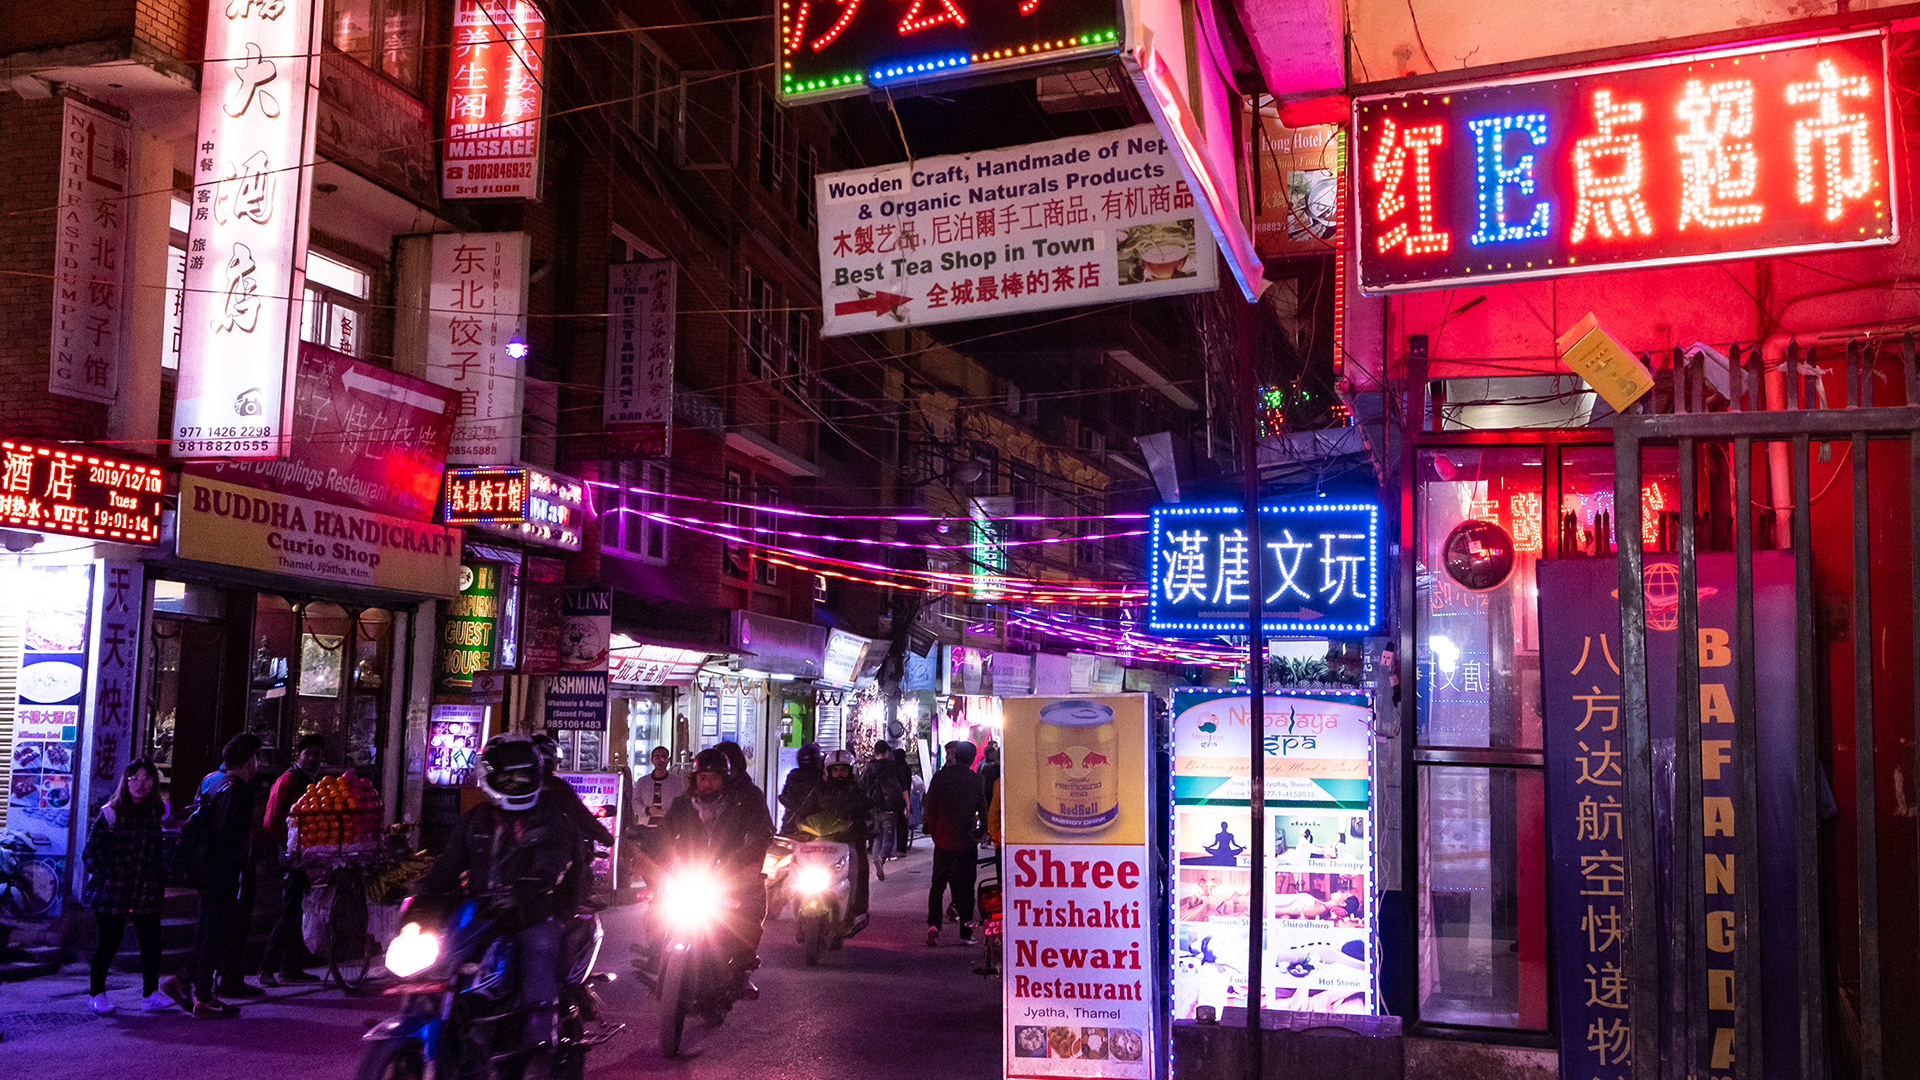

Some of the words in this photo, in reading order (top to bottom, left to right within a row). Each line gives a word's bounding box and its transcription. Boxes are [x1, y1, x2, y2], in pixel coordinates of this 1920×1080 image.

[450, 27, 491, 119] 养生阁
[501, 25, 542, 118] 中式按摩
[451, 121, 535, 140] CHINESE
[1293, 131, 1322, 149] Hotel
[201, 141, 215, 172] 中餐
[449, 140, 535, 157] MASSAGE
[1374, 58, 1873, 256] 红E点超市
[468, 162, 532, 180] 9803846932
[829, 175, 903, 199] Wooden
[911, 165, 971, 188] Craft,
[977, 149, 1095, 179] Handmade
[1098, 140, 1120, 159] of
[1127, 135, 1170, 157] Nep
[456, 184, 479, 194] 3rd
[482, 183, 520, 194] FLOOR
[858, 203, 874, 221] &
[877, 191, 962, 222] Organic
[967, 176, 1059, 203] Naturals
[1066, 161, 1165, 190] Products
[195, 189, 211, 221] 客房
[190, 238, 207, 270] 旅游
[835, 262, 884, 287] Best
[892, 257, 933, 279] Tea
[939, 247, 998, 277] Shop
[1004, 243, 1025, 263] in
[1032, 235, 1095, 260] Town
[84, 197, 119, 389] 东北饺子馆
[490, 241, 501, 347] DUMPLING
[926, 262, 1101, 309] 全城最棒的茶店
[486, 352, 496, 418] HOUSE
[619, 411, 643, 421] BAR
[178, 441, 269, 451] 9818820555
[180, 427, 201, 438] 977
[208, 427, 237, 438] 1426
[240, 427, 271, 438] 2298
[2, 451, 78, 501] 酒店
[90, 466, 159, 494] 2019/12/10
[325, 467, 389, 499] Restaurant
[109, 490, 138, 510] Tues
[452, 479, 522, 513] 东北饺子馆
[94, 509, 149, 533] 19:01:14
[193, 485, 304, 533] BUDDHA
[314, 509, 457, 557] HANDICRAFT
[267, 532, 327, 560] Curio
[332, 542, 381, 567] Shop
[277, 556, 315, 573] Thamel,
[316, 561, 349, 579] Jyatha,
[350, 565, 371, 579] Ktm.
[1163, 528, 1367, 604] 漢唐文玩
[444, 620, 492, 646] GUEST
[94, 567, 130, 782] 天天快递
[443, 649, 491, 674] HOUSE
[545, 675, 606, 695] PASHMINA
[546, 720, 602, 729] 9851061483
[1264, 763, 1283, 773] ody,
[1285, 762, 1317, 772] Mind
[1331, 762, 1361, 773] Soul
[1290, 780, 1313, 788] Thamel
[1051, 816, 1083, 825] ENERGY
[1083, 815, 1107, 825] DRINK
[1014, 848, 1140, 889] Shree
[1308, 859, 1326, 868] Thai
[1328, 859, 1365, 870] Therapy
[1571, 633, 1634, 1080] 八方达航空快递物
[1014, 899, 1142, 929] Trishakti
[1282, 920, 1330, 929] Shirodhara
[1015, 940, 1142, 970] Newari
[1015, 975, 1142, 1002] Restaurant
[1318, 978, 1334, 987] Hot
[1336, 978, 1361, 987] Stone
[1023, 1006, 1070, 1020] Jyatha,
[1073, 1007, 1121, 1019] Thamel
